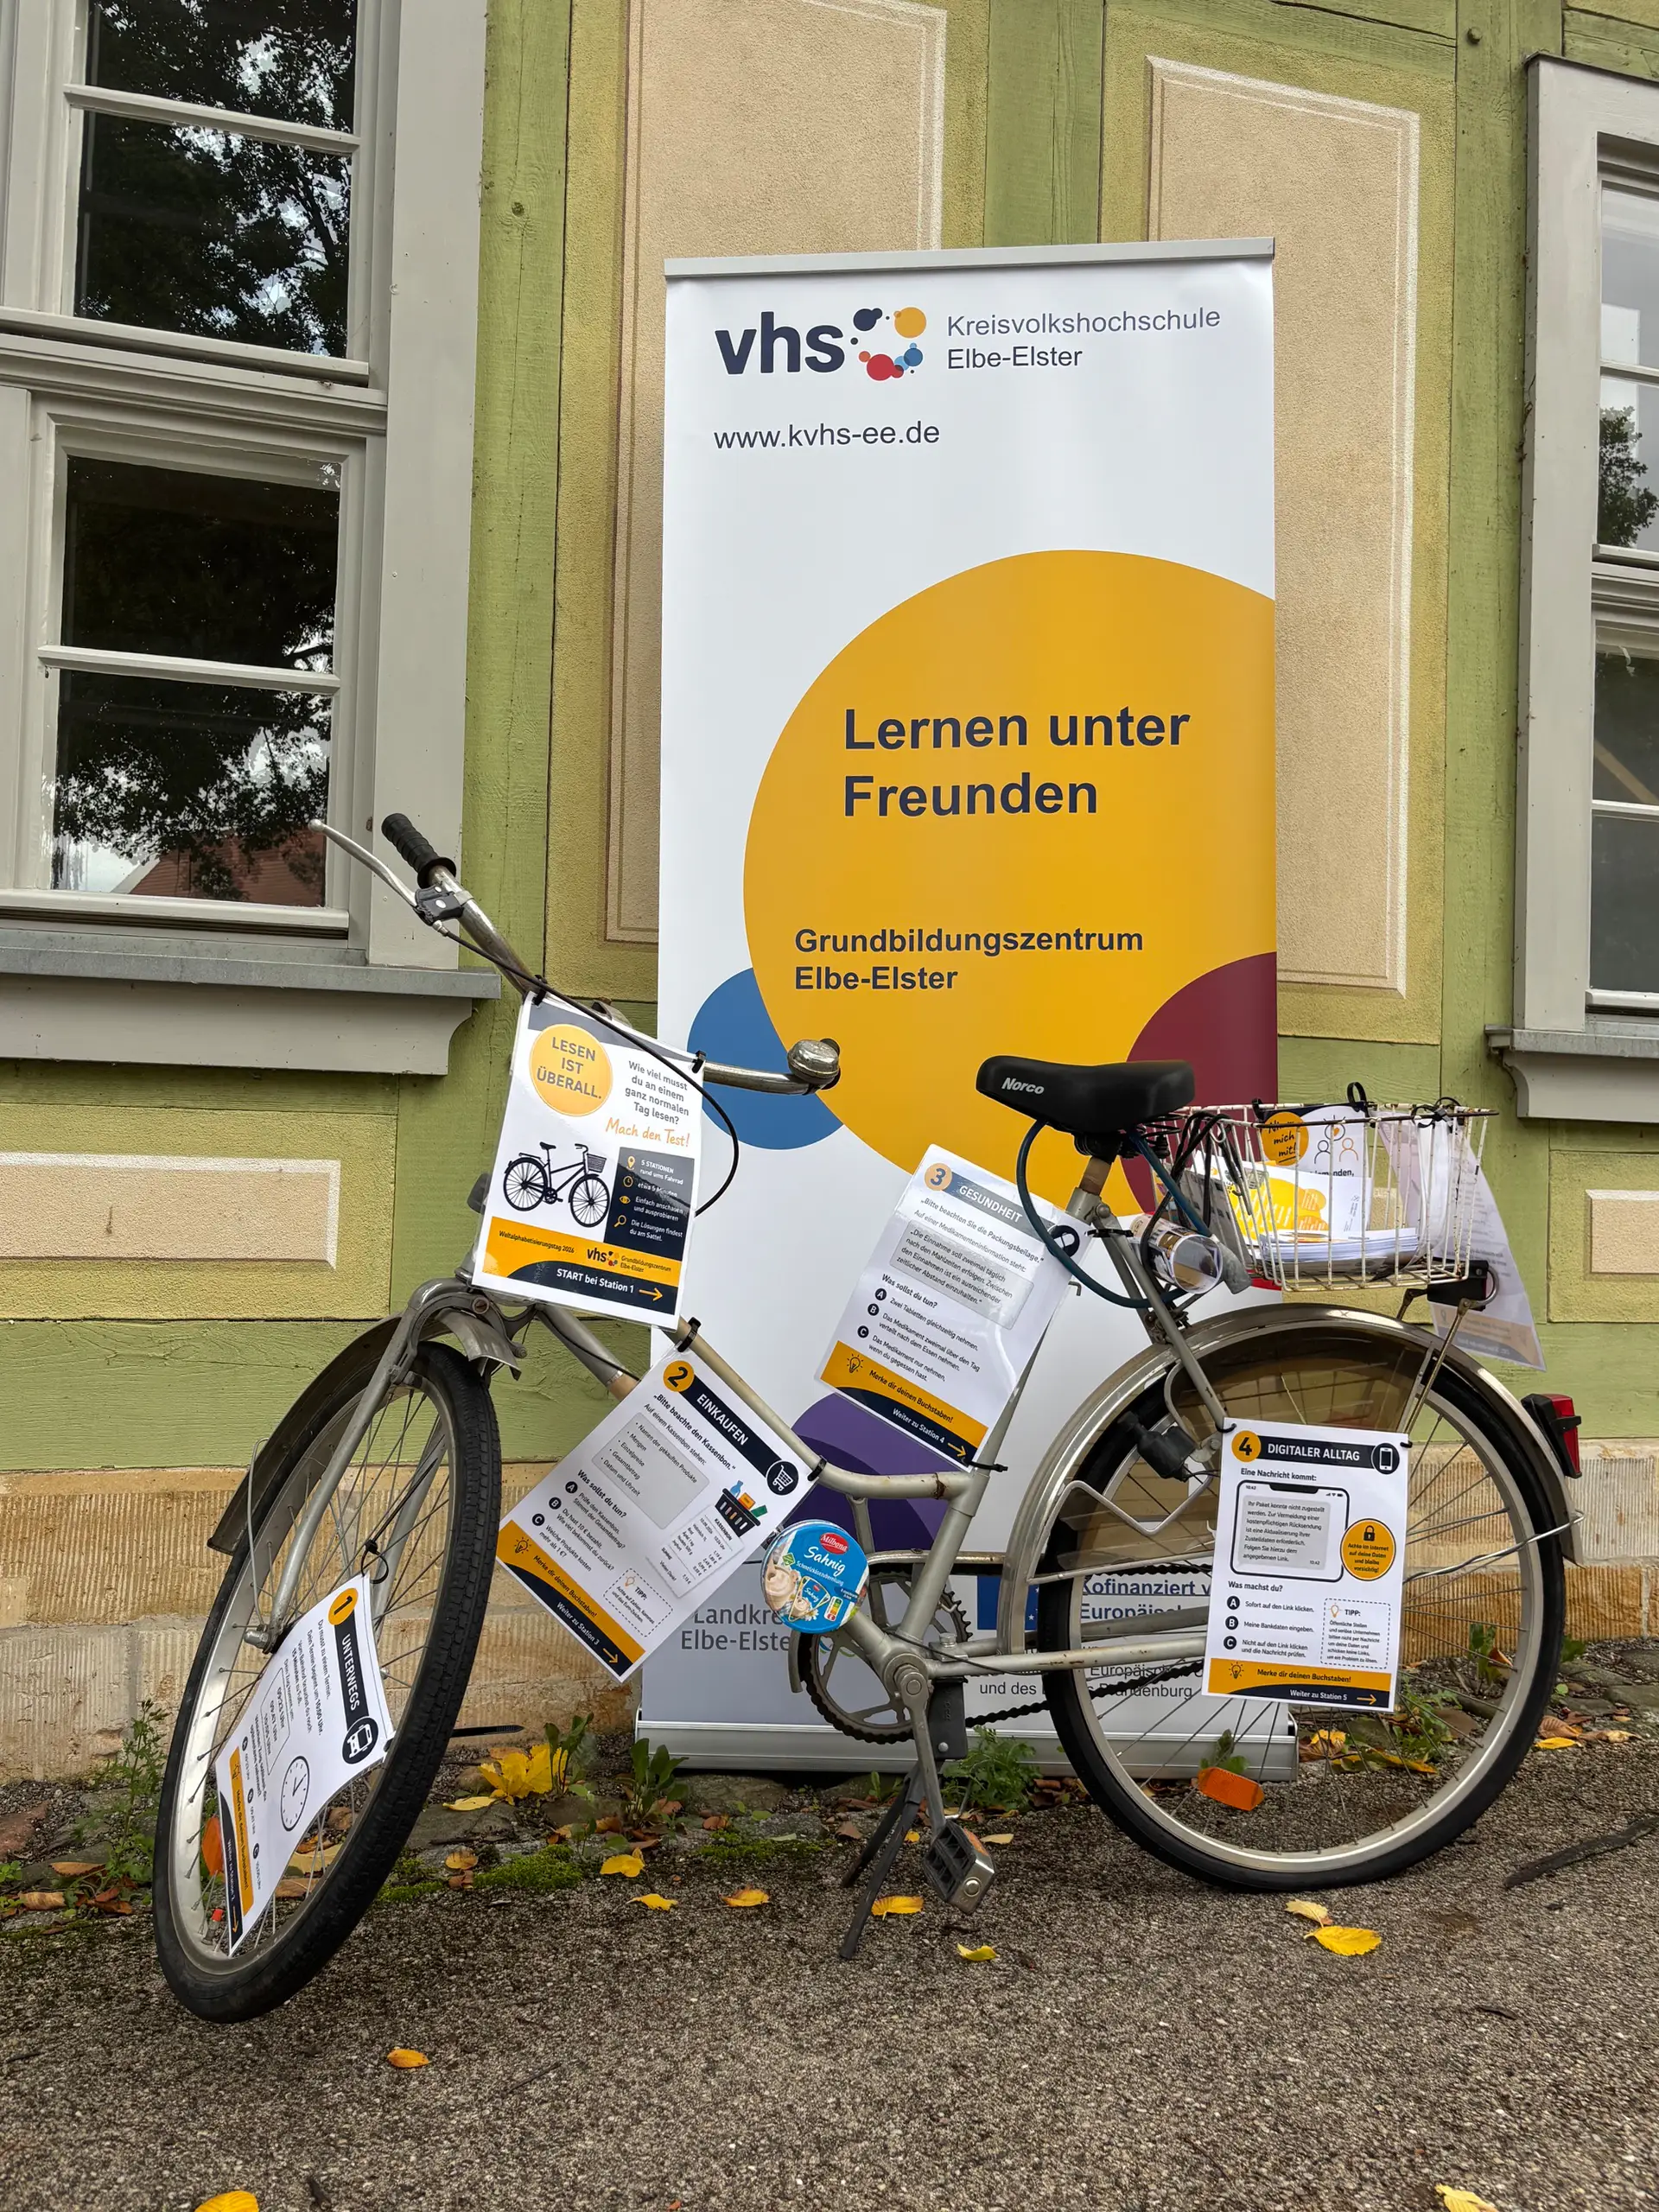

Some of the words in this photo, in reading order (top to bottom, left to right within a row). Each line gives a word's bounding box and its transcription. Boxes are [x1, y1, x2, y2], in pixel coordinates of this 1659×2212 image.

[947, 307, 1221, 337] Kreisvolkshochschule
[715, 312, 845, 375] vhs
[947, 346, 1083, 372] Elbe-Elster
[714, 422, 940, 449] www.kvhs-ee.de
[844, 709, 1028, 750] Lernen
[1048, 708, 1191, 747] unter
[844, 773, 1097, 817] Freunden
[794, 928, 1144, 957] Grundbildungszentrum
[794, 967, 958, 991] Elbe-Elster
[551, 1036, 596, 1061] LESEN
[561, 1058, 583, 1074] IST
[627, 1060, 645, 1073] Wie
[646, 1067, 661, 1080] viel
[663, 1074, 688, 1090] musst
[536, 1065, 603, 1099] ÜBERALL.
[632, 1075, 643, 1086] du
[645, 1082, 656, 1091] an
[658, 1084, 684, 1102] einem
[1001, 1077, 1045, 1095] Norco
[625, 1087, 646, 1103] ganz
[648, 1094, 689, 1116] normalen
[632, 1101, 650, 1116] Tag
[652, 1108, 679, 1125] lesen?
[605, 1117, 639, 1136] Mach
[642, 1127, 661, 1141] den
[663, 1128, 690, 1147] Test!
[1274, 1130, 1294, 1144] mich
[1279, 1142, 1297, 1156] mit!
[645, 1160, 673, 1173] STATIONEN
[664, 1174, 683, 1184] Fahrrad
[929, 1166, 947, 1187] 3
[635, 1196, 654, 1206] Einfach
[655, 1201, 683, 1213] anschauen
[645, 1208, 678, 1222] ausprobieren
[957, 1184, 1023, 1223] GESUNDHEIT
[640, 1221, 664, 1234] Lösungen
[665, 1227, 682, 1236] findest
[646, 1232, 662, 1241] Sattel.
[920, 1196, 939, 1211] „Bitte
[938, 1205, 967, 1224] beachten
[966, 1219, 977, 1229] Sie
[976, 1224, 988, 1235] die
[986, 1230, 1044, 1265] Packungsbeilage.“
[586, 1246, 607, 1262] vhs
[556, 1268, 583, 1281] START
[585, 1274, 597, 1284] bei
[599, 1277, 626, 1291] Station
[629, 1284, 633, 1293] 1
[880, 1274, 895, 1286] Was
[895, 1281, 913, 1295] sollst
[912, 1291, 922, 1300] du
[921, 1296, 938, 1308] tun?
[667, 1363, 690, 1388] 2
[868, 1370, 887, 1384] Merke
[887, 1380, 896, 1389] dir
[896, 1385, 917, 1402] deinen
[916, 1397, 953, 1422] Buchstaben!
[653, 1391, 672, 1410] „Bitte
[669, 1406, 693, 1430] beachte
[690, 1427, 704, 1440] den
[701, 1438, 735, 1472] Kassenbon.“
[696, 1393, 749, 1446] EINKAUFEN
[892, 1408, 912, 1423] Weiter
[918, 1424, 939, 1440] Station
[627, 1433, 648, 1452] Mengen
[644, 1402, 655, 1414] Auf
[652, 1410, 668, 1427] einem
[665, 1423, 691, 1450] Kassenbon
[689, 1446, 708, 1465] stehen:
[1238, 1436, 1252, 1455] 4
[619, 1441, 645, 1467] Einzelpreise
[1268, 1443, 1320, 1457] DIGITALER
[1323, 1448, 1359, 1460] ALLTAG
[602, 1459, 619, 1474] Datum
[616, 1471, 626, 1482] und
[625, 1480, 640, 1496] Uhrzeit
[610, 1450, 641, 1480] Gesamtbetrag
[1257, 1469, 1289, 1478] Nachricht
[576, 1469, 591, 1484] Was
[588, 1481, 606, 1498] sollst
[603, 1496, 616, 1508] du
[613, 1505, 626, 1519] tun?
[713, 1518, 732, 1541] KASSENBON
[820, 1534, 848, 1552] Milbona
[804, 1547, 846, 1577] Sahnig
[533, 1554, 550, 1570] Merke
[548, 1569, 558, 1579] dir
[556, 1577, 572, 1592] deinen
[570, 1591, 597, 1618] Buchstaben!
[334, 1595, 353, 1616] 1
[694, 1604, 782, 1624] Landkre
[556, 1601, 575, 1620] Weiter
[573, 1619, 582, 1628] zu
[580, 1625, 595, 1641] Station
[318, 1617, 323, 1630] Du
[321, 1646, 325, 1656] zu
[682, 1629, 790, 1650] Elbe-Elste
[341, 1630, 359, 1714] UNTERWEGS
[1312, 1673, 1351, 1682] Buchstaben!
[314, 1688, 318, 1700] um
[980, 1681, 1006, 1694] und
[1011, 1681, 1037, 1694] des
